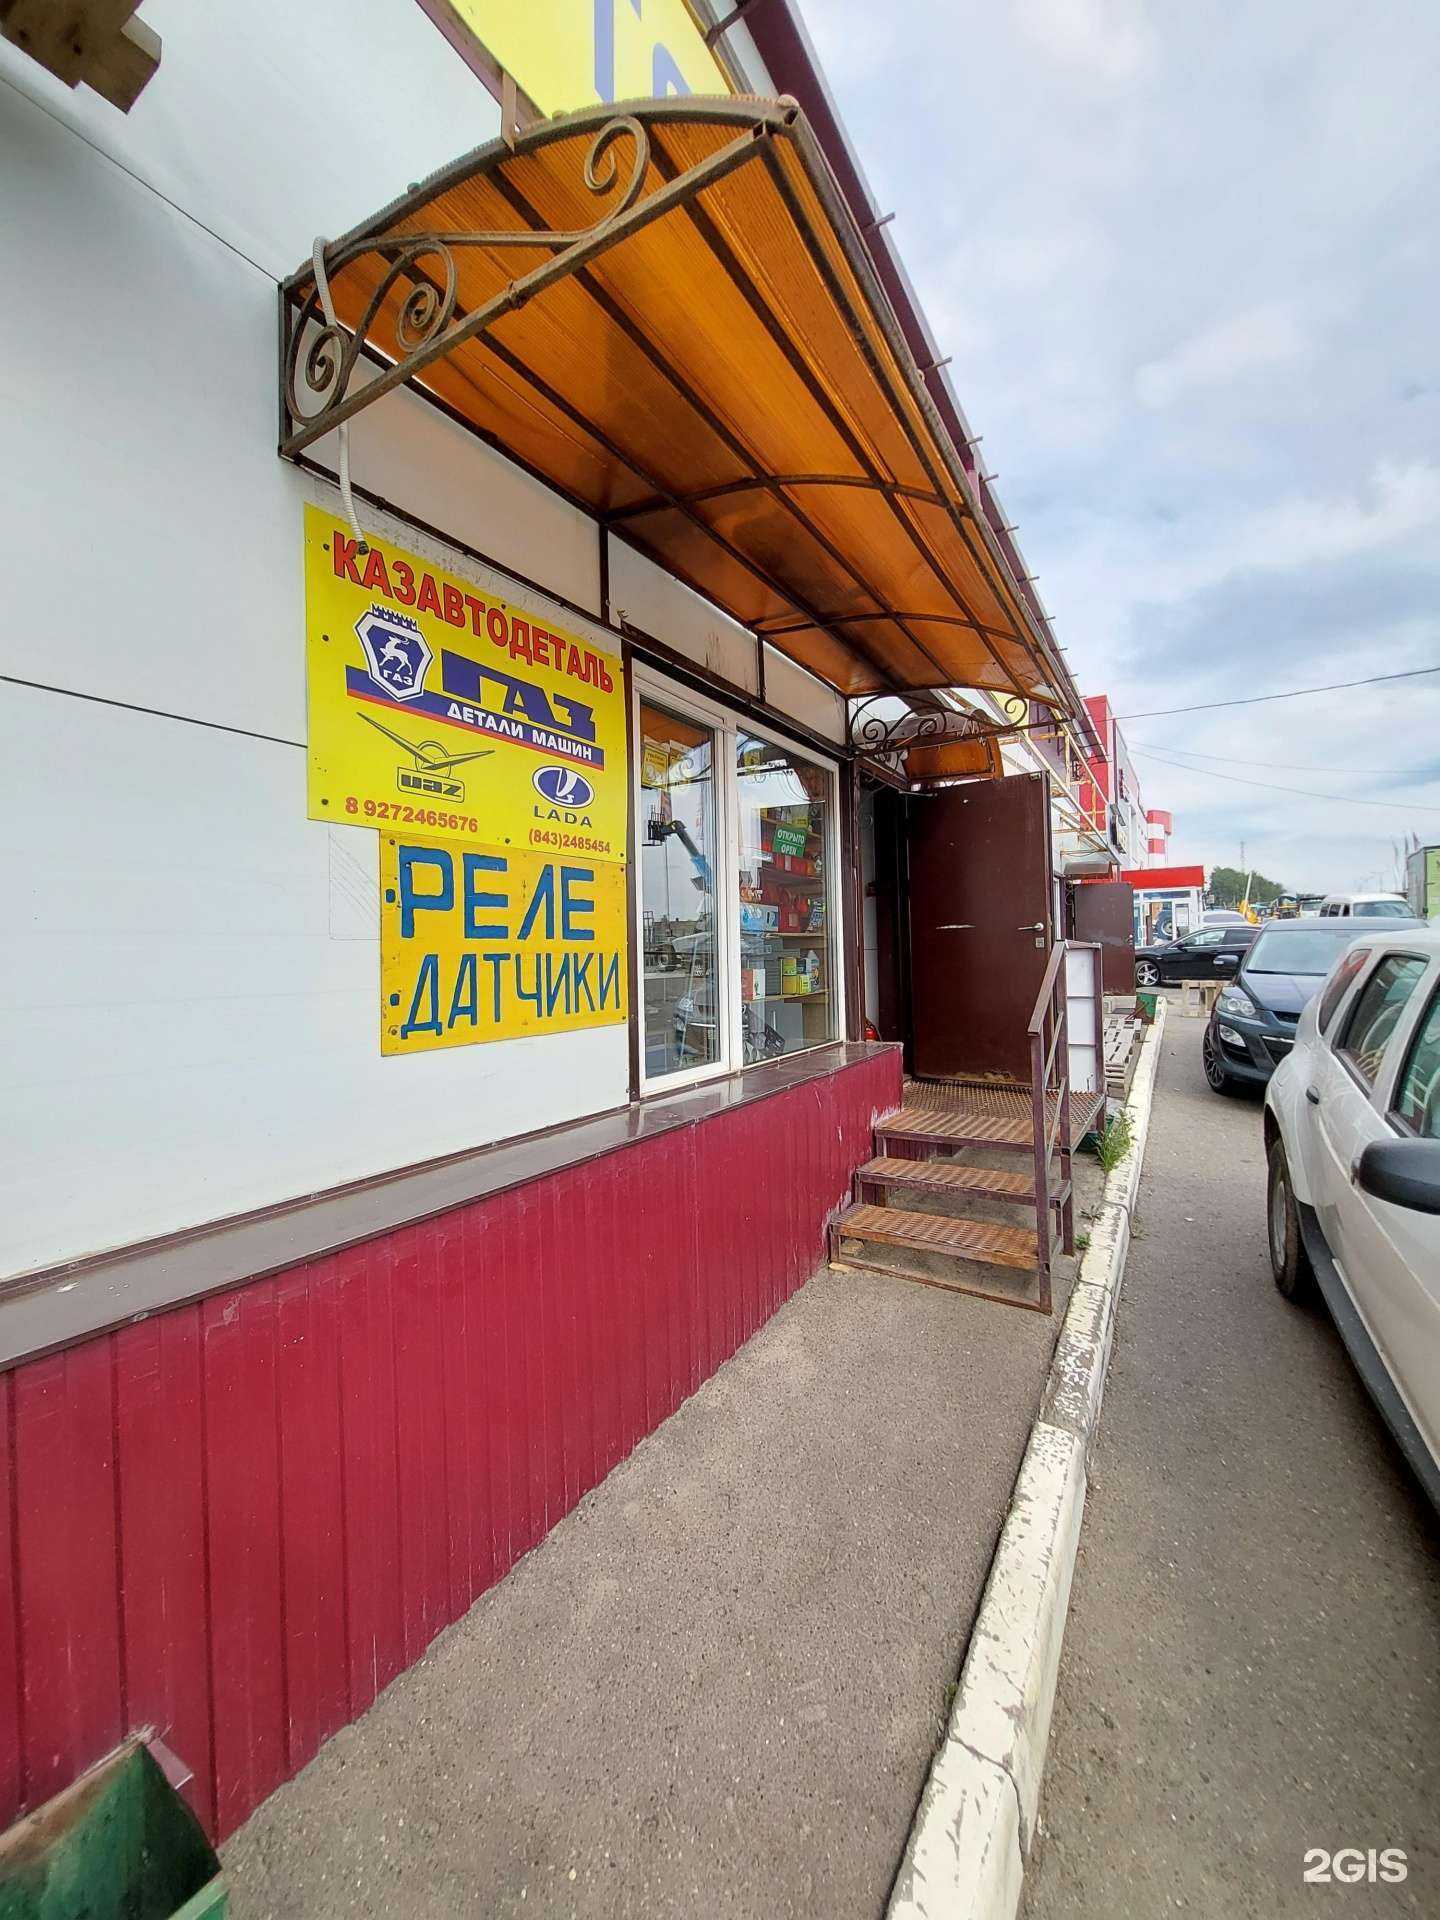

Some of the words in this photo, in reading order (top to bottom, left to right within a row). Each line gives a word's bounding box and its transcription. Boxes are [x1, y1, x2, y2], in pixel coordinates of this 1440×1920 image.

[333, 530, 613, 693] КАЗАВТОДЕТАЛЬ
[383, 670, 413, 686] ГАЗ
[441, 649, 596, 742] ГАЗ
[447, 702, 524, 739] ДЕТАЛИ
[532, 729, 593, 760] МАШИН
[345, 796, 359, 814] 8
[363, 799, 479, 833] 9272465676
[534, 805, 593, 828] LADA
[528, 828, 612, 854] (843)2485454
[777, 829, 805, 844] ОТКРЫТО
[781, 844, 797, 856] OPEN
[399, 845, 595, 940] РЕЛЕ
[400, 952, 621, 1040] ДАТЧИКИ
